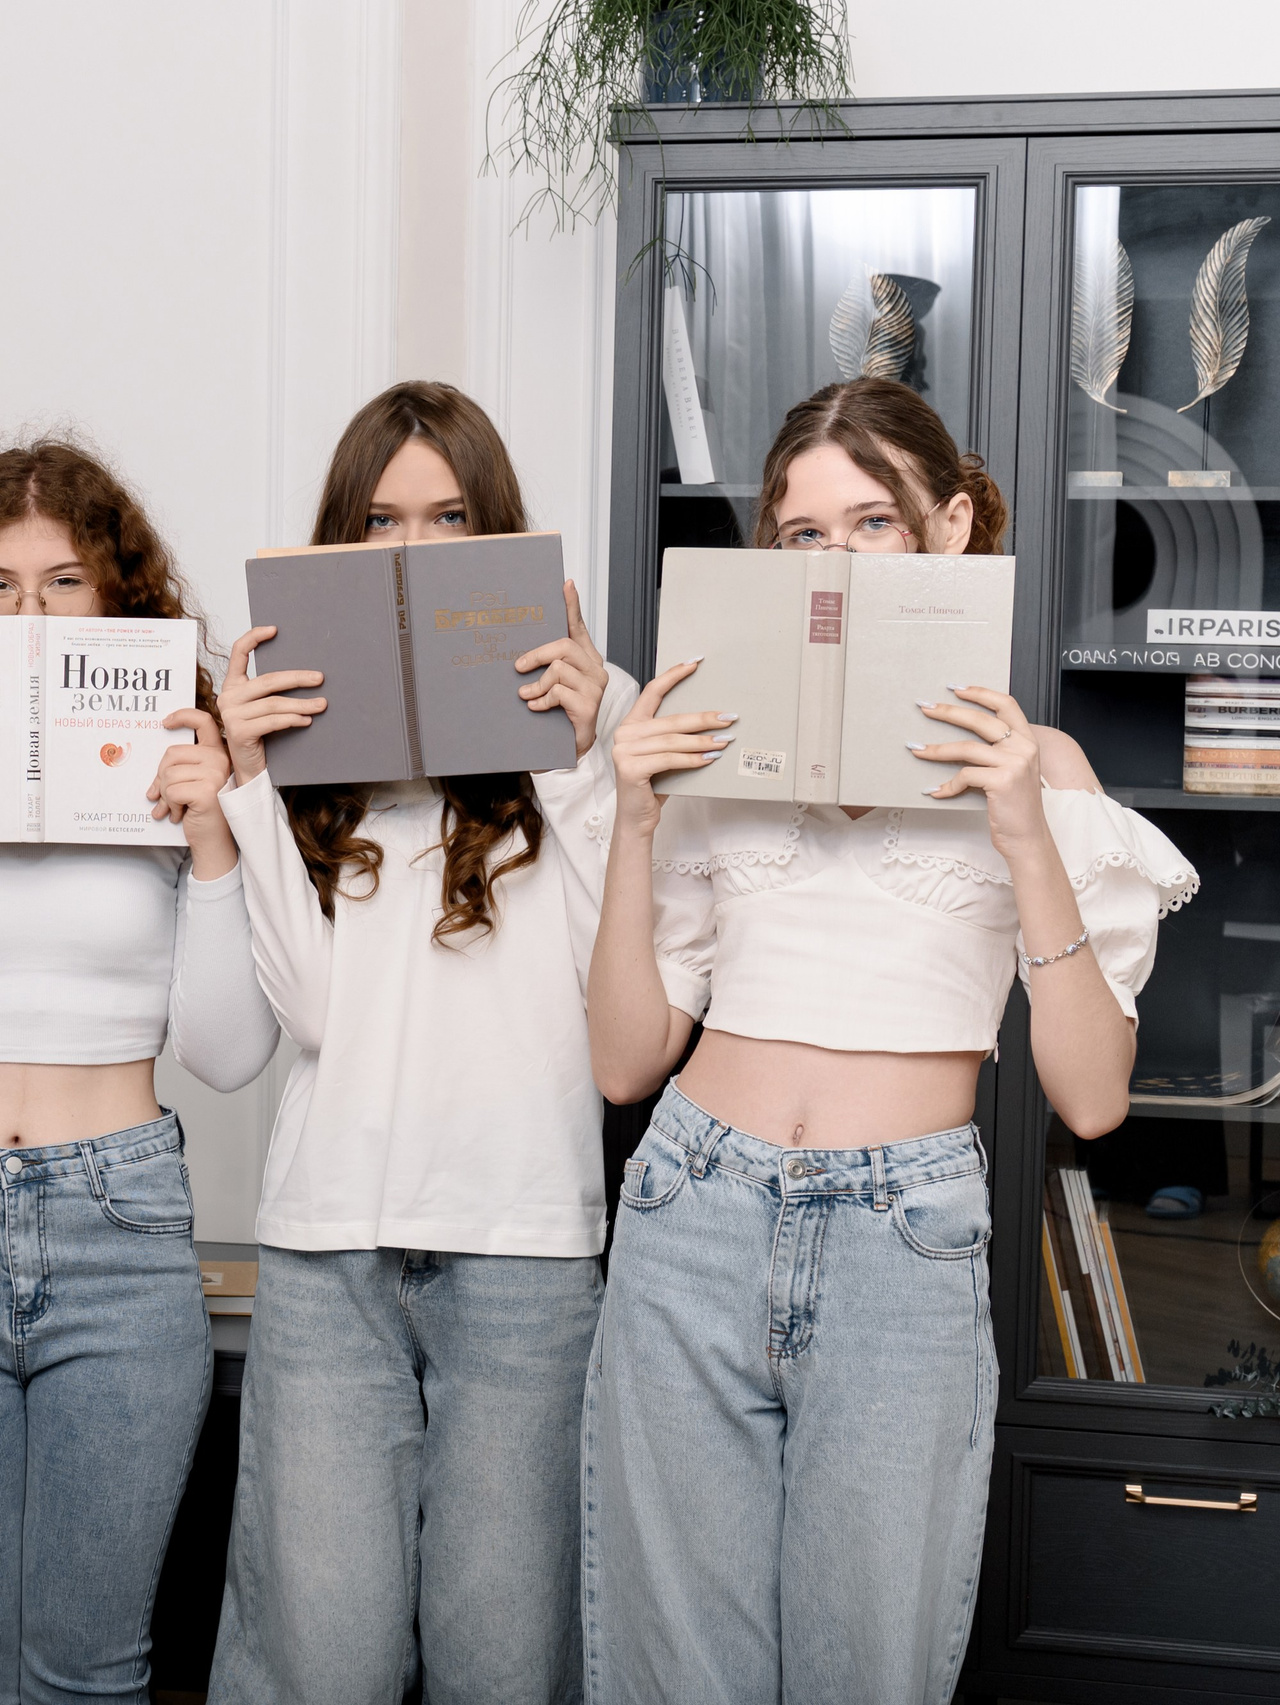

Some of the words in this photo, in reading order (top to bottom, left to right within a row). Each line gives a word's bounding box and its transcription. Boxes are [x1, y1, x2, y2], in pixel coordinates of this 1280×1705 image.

[899, 605, 926, 614] Томас
[928, 606, 965, 615] Пинчон
[60, 654, 172, 691] Новая
[30, 675, 40, 725] земля
[72, 693, 158, 713] земля
[1218, 706, 1280, 715] BURBER
[55, 717, 94, 729] НОВЫЙ
[97, 719, 131, 729] ОБРАЗ
[134, 720, 167, 730] ЖИЗН
[27, 731, 41, 782] Новая
[73, 812, 113, 822] ЭКХАРТ
[117, 813, 152, 823] ТОЛЛЕ
